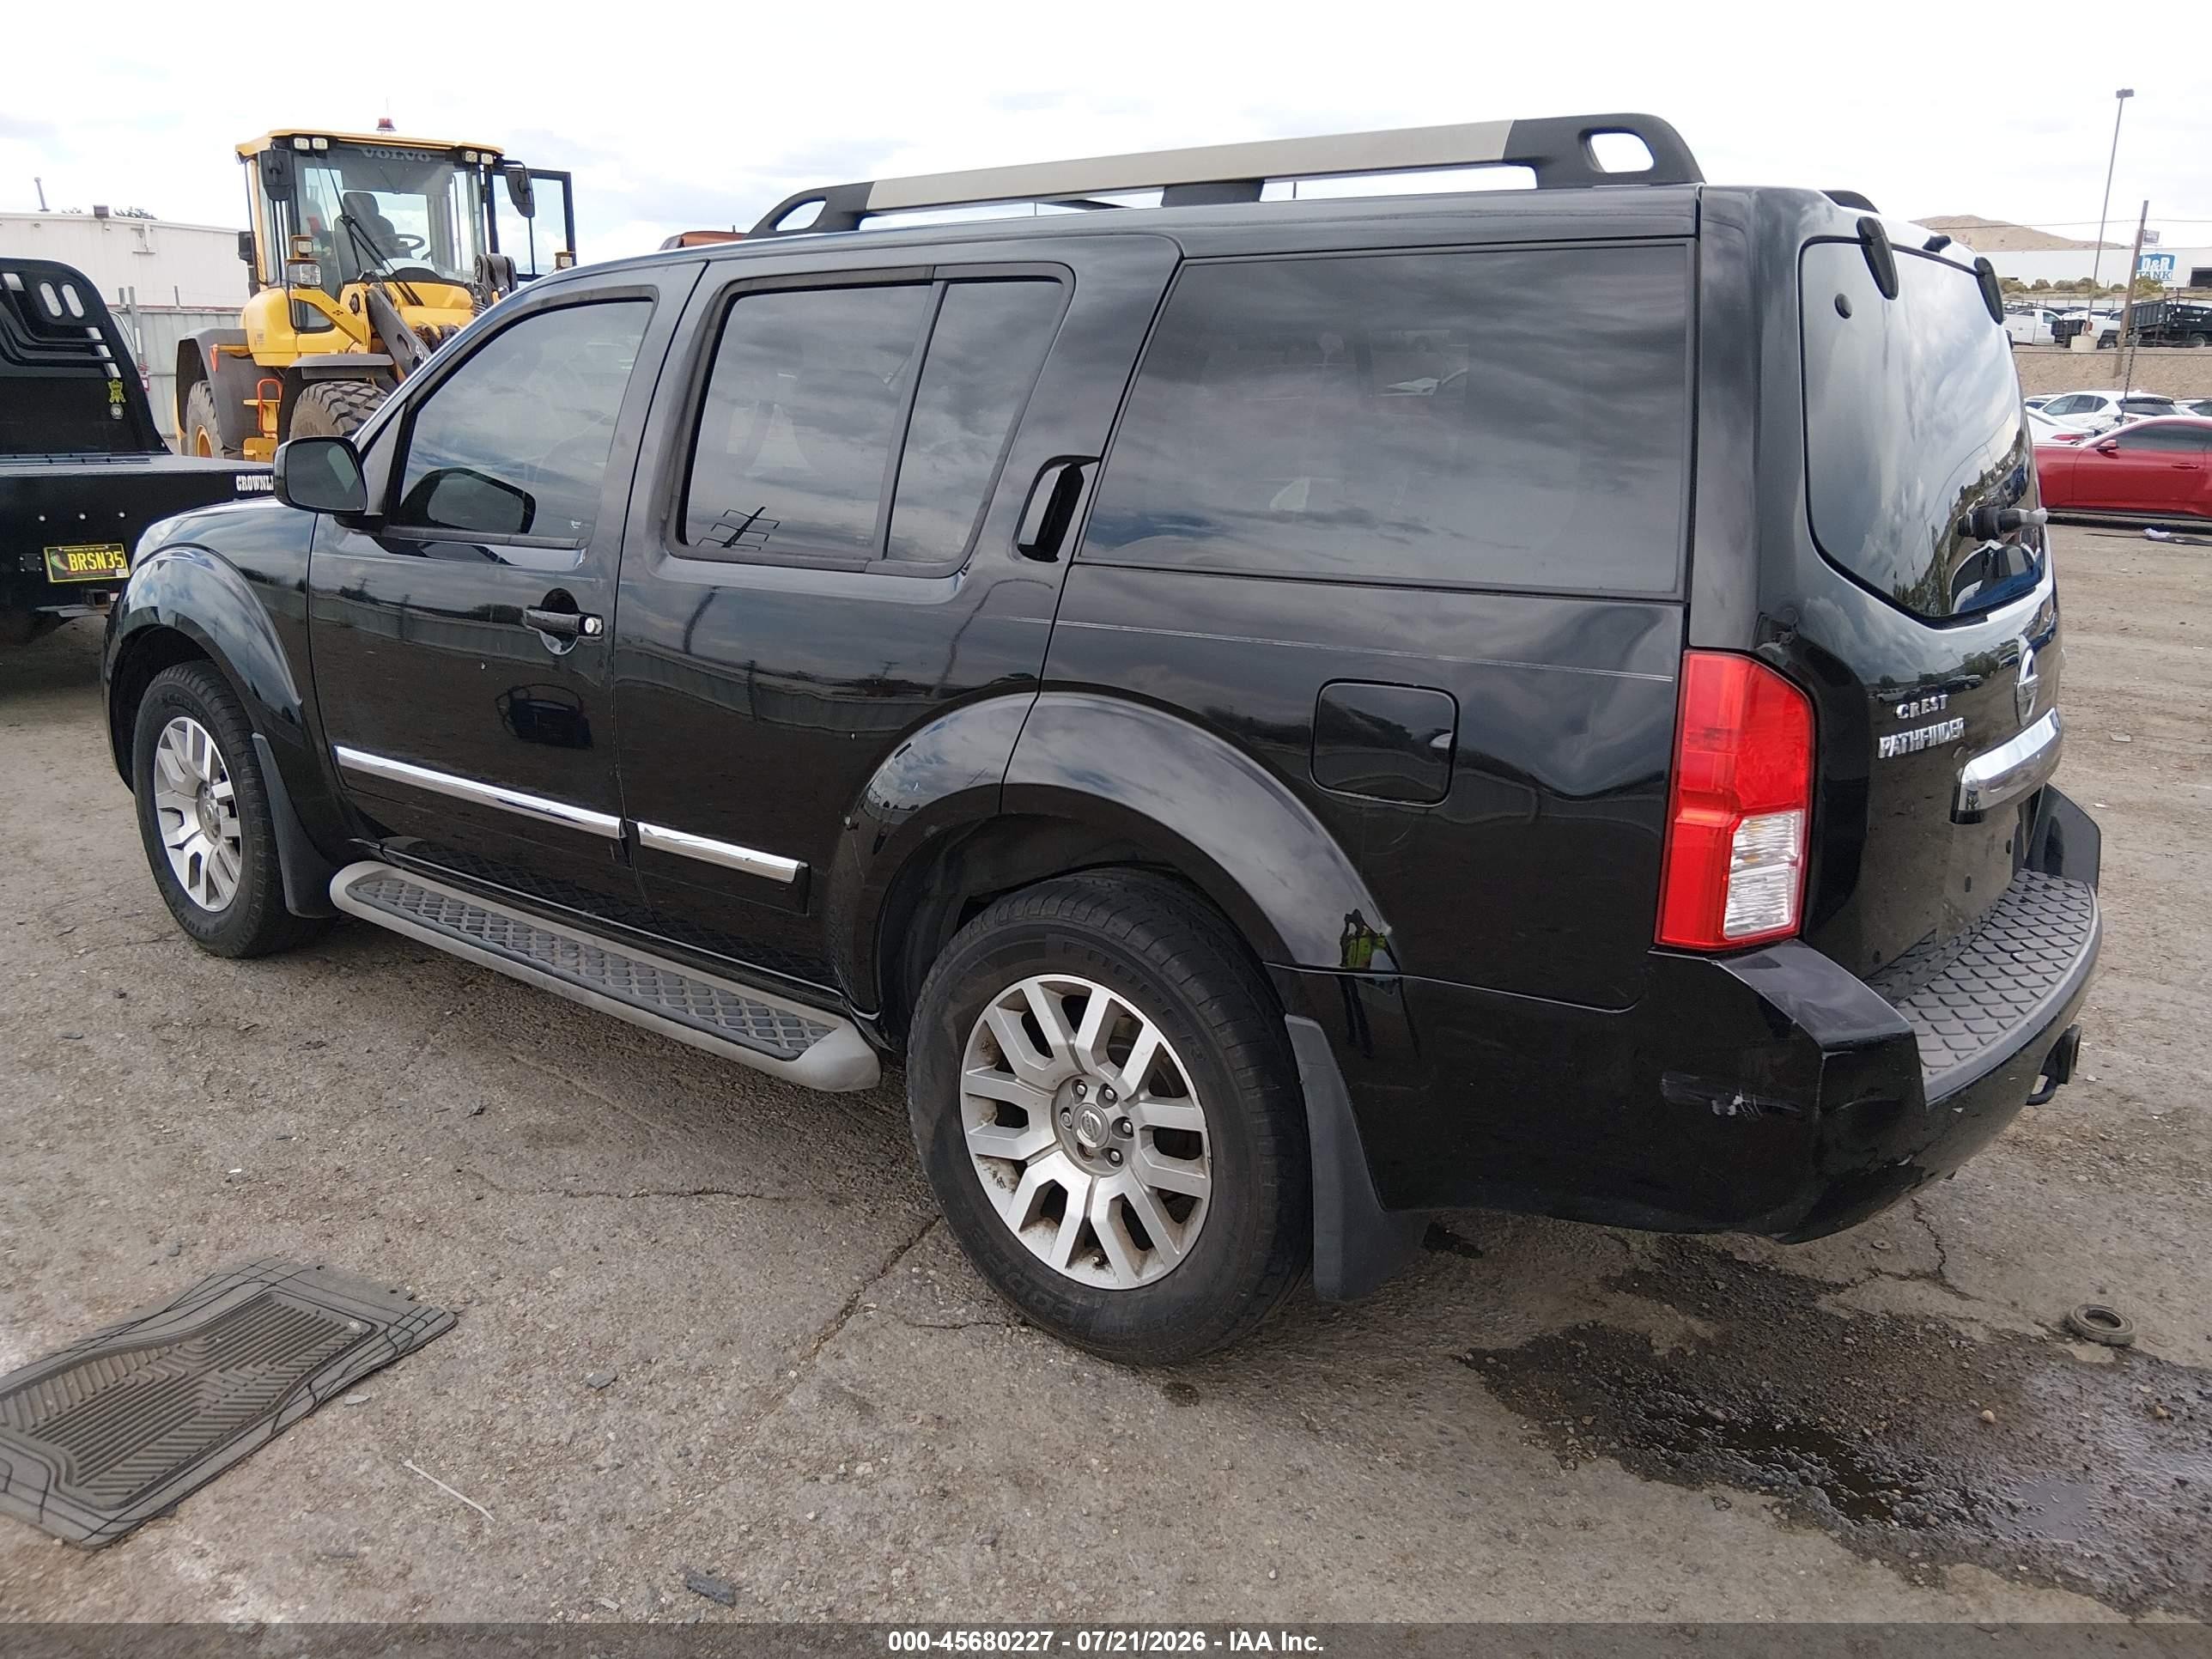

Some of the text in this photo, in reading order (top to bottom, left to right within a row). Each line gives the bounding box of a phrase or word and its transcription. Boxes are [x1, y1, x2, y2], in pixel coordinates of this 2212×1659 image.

[362, 146, 431, 162] VOLVO
[68, 550, 125, 572] BRSN35
[1895, 694, 1948, 719] CREST
[1878, 717, 1965, 758] PATHFINDER
